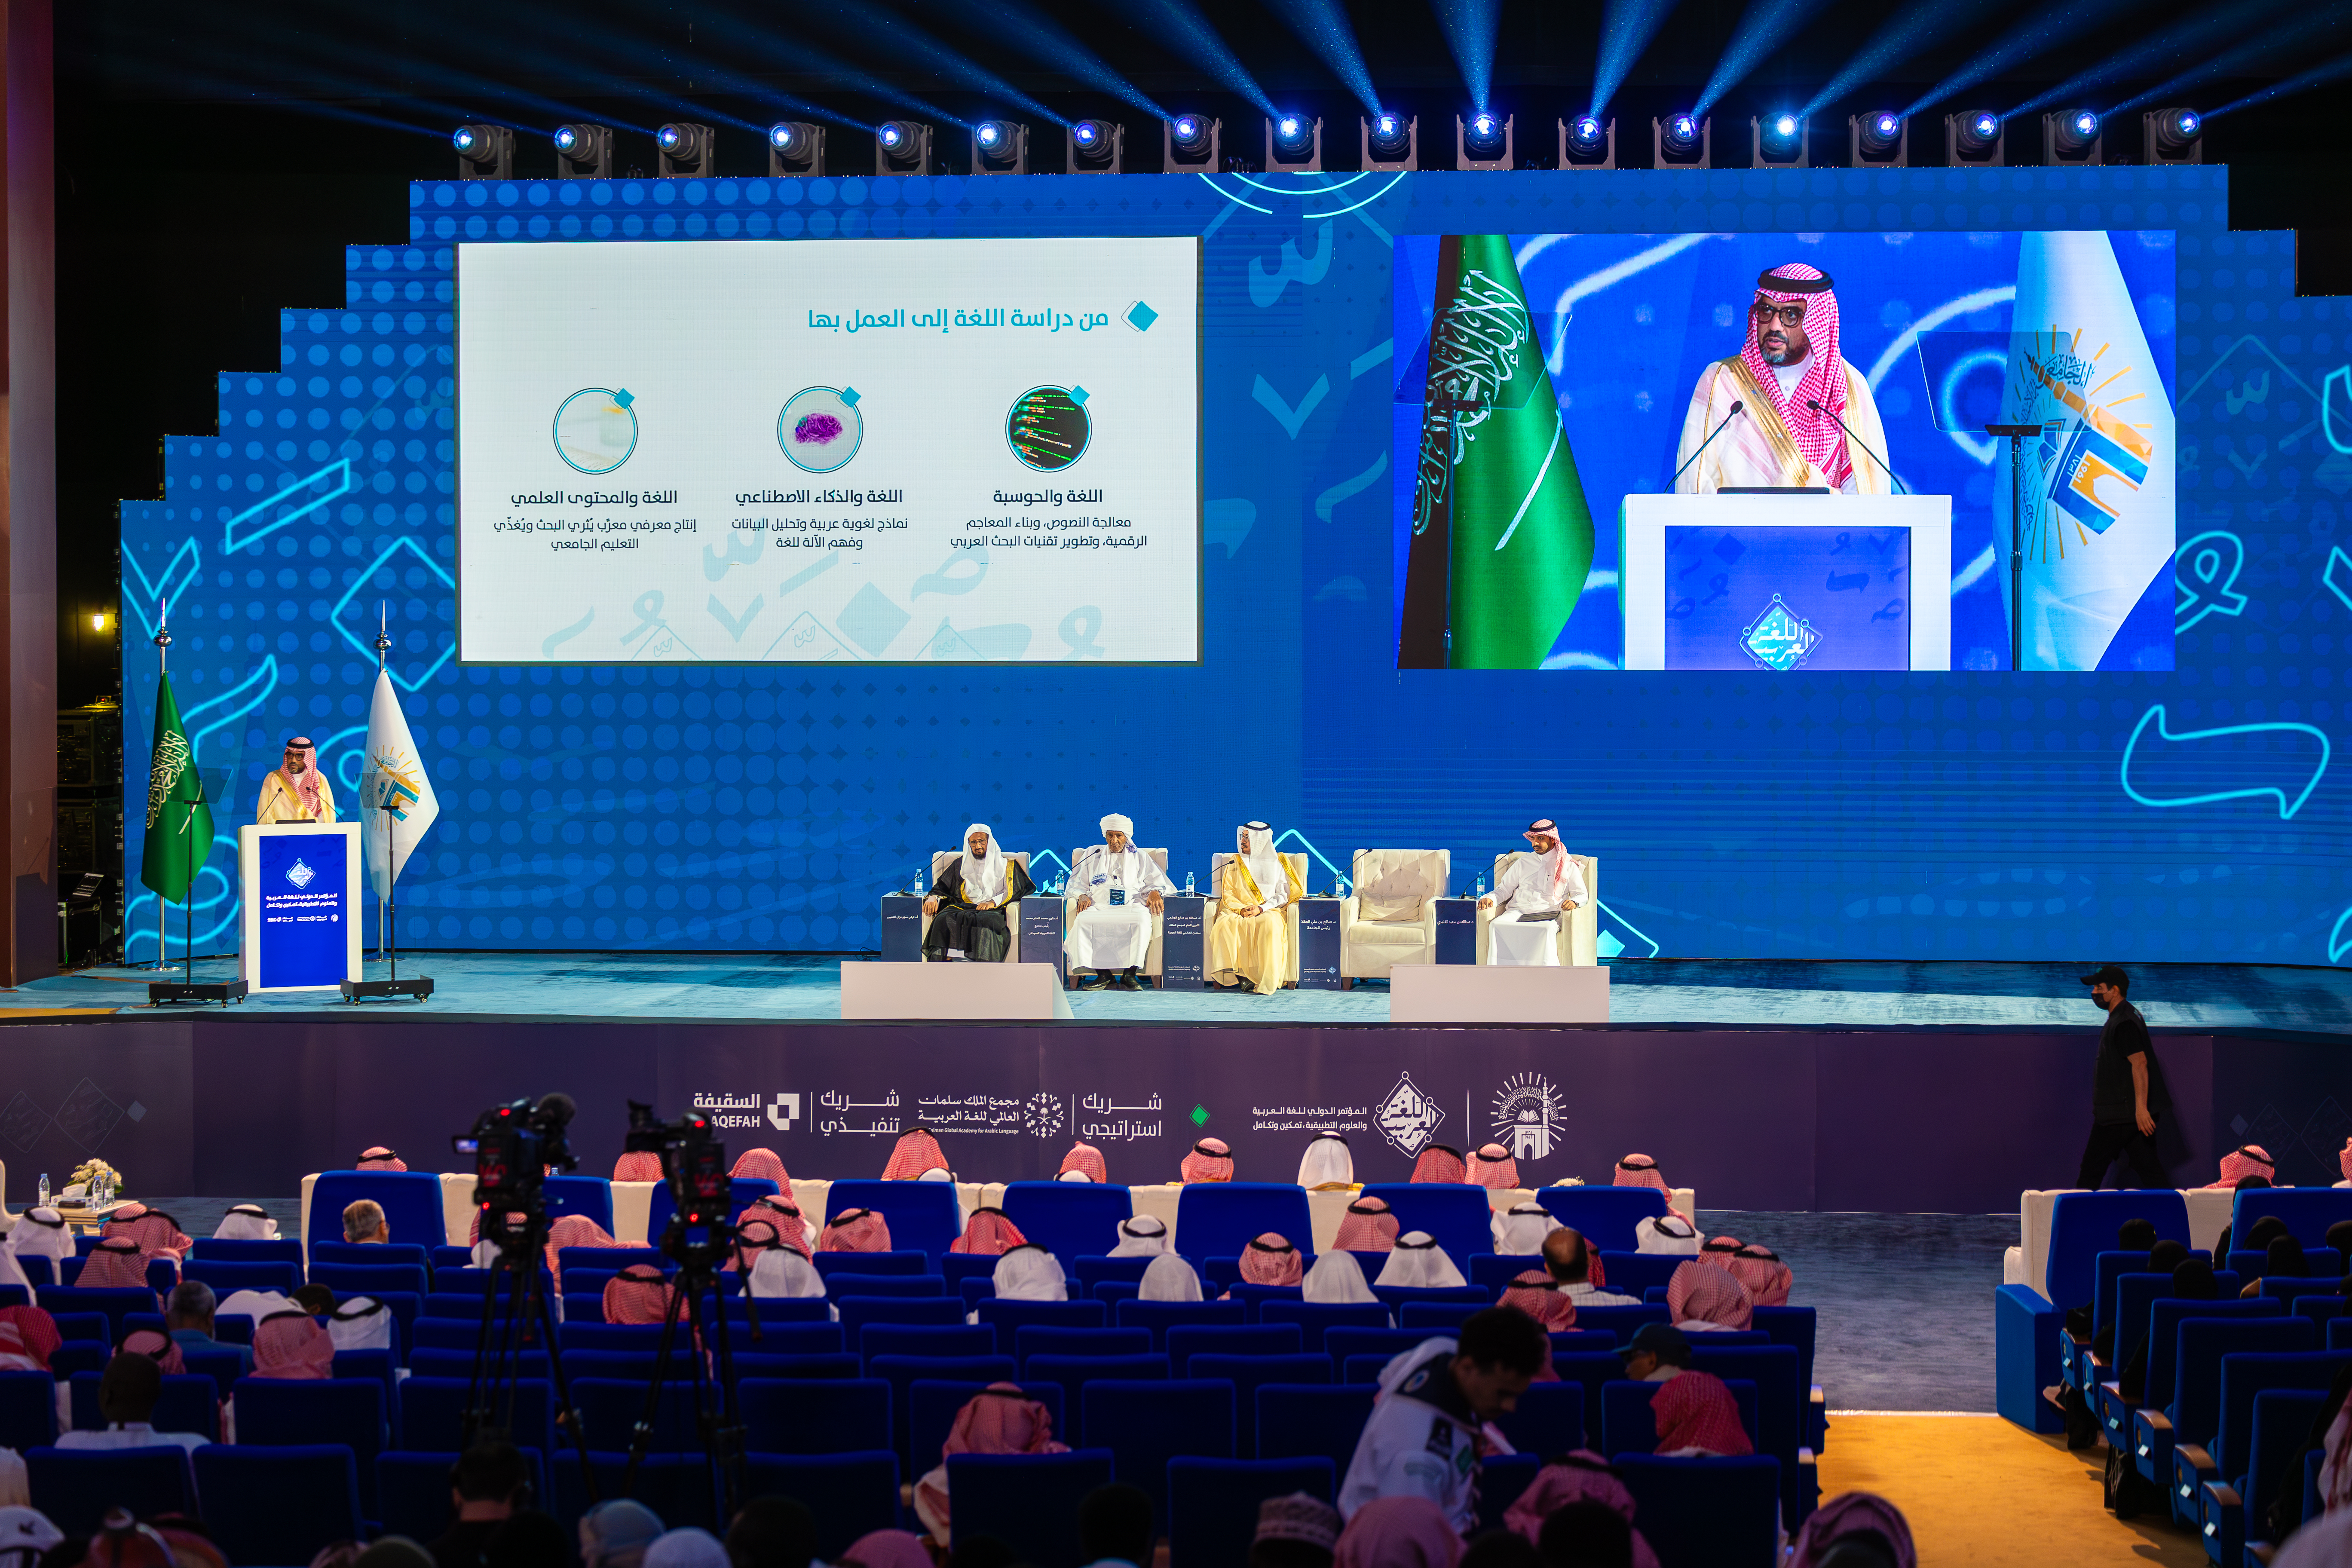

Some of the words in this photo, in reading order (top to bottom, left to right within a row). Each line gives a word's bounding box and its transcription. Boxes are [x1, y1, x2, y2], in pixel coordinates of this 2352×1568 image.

[809, 309, 840, 333] بها
[845, 309, 904, 333] العمل
[912, 309, 949, 333] إلى
[954, 308, 1004, 327] اللغة
[1011, 308, 1073, 332] دراسة
[1079, 312, 1108, 331] من
[511, 491, 563, 508] العلمي
[567, 491, 638, 508] والمحتوى
[642, 490, 677, 504] اللغة
[735, 489, 810, 506] الاصطناعي
[814, 489, 863, 506] والذكاء
[867, 490, 903, 502] اللغة
[993, 489, 1063, 506] والحوسبة
[1067, 489, 1102, 503] اللغة
[536, 519, 564, 533] البحث
[630, 519, 671, 533] معرفي
[674, 519, 697, 533] إنتاج
[732, 518, 769, 531] البيانات
[772, 518, 807, 532] وتحليل
[810, 518, 839, 532] عربية
[842, 518, 874, 532] لغوية
[877, 518, 908, 532] نماذج
[966, 517, 1011, 531] المعاجم
[1015, 517, 1041, 530] وبناء
[1043, 516, 1089, 531] النصوص،
[1093, 517, 1131, 530] معالجة
[551, 538, 597, 551] الجامعي
[601, 538, 638, 552] التعليم
[776, 536, 799, 547] للغة
[803, 534, 825, 547] الآلة
[828, 538, 863, 551] وفهم
[950, 536, 988, 549] العربي
[991, 535, 1020, 548] البحث
[1024, 536, 1058, 548] تقنيات
[1060, 535, 1099, 549] وتطوير
[1102, 535, 1147, 549] الرقمية،
[693, 1093, 760, 1112] السقيفة
[820, 1089, 899, 1112] شريك
[918, 1094, 962, 1106] سلمان
[964, 1095, 986, 1106] الملك
[989, 1097, 1019, 1110] مجمع
[1083, 1092, 1161, 1115] شريك
[918, 1110, 962, 1124] العربية
[964, 1110, 987, 1121] للغة
[1253, 1106, 1285, 1116] العربية
[1307, 1107, 1335, 1117] الدولي
[1337, 1106, 1367, 1117] المؤتمر
[711, 1115, 760, 1129] AQEFAH
[989, 1111, 1019, 1127] العالمي
[1253, 1121, 1278, 1130] وتكامل
[1280, 1121, 1302, 1130] تمكين
[1339, 1121, 1367, 1131] والعلوم
[820, 1117, 900, 1137] تنفيذي
[1082, 1120, 1161, 1142] استراتيجي
